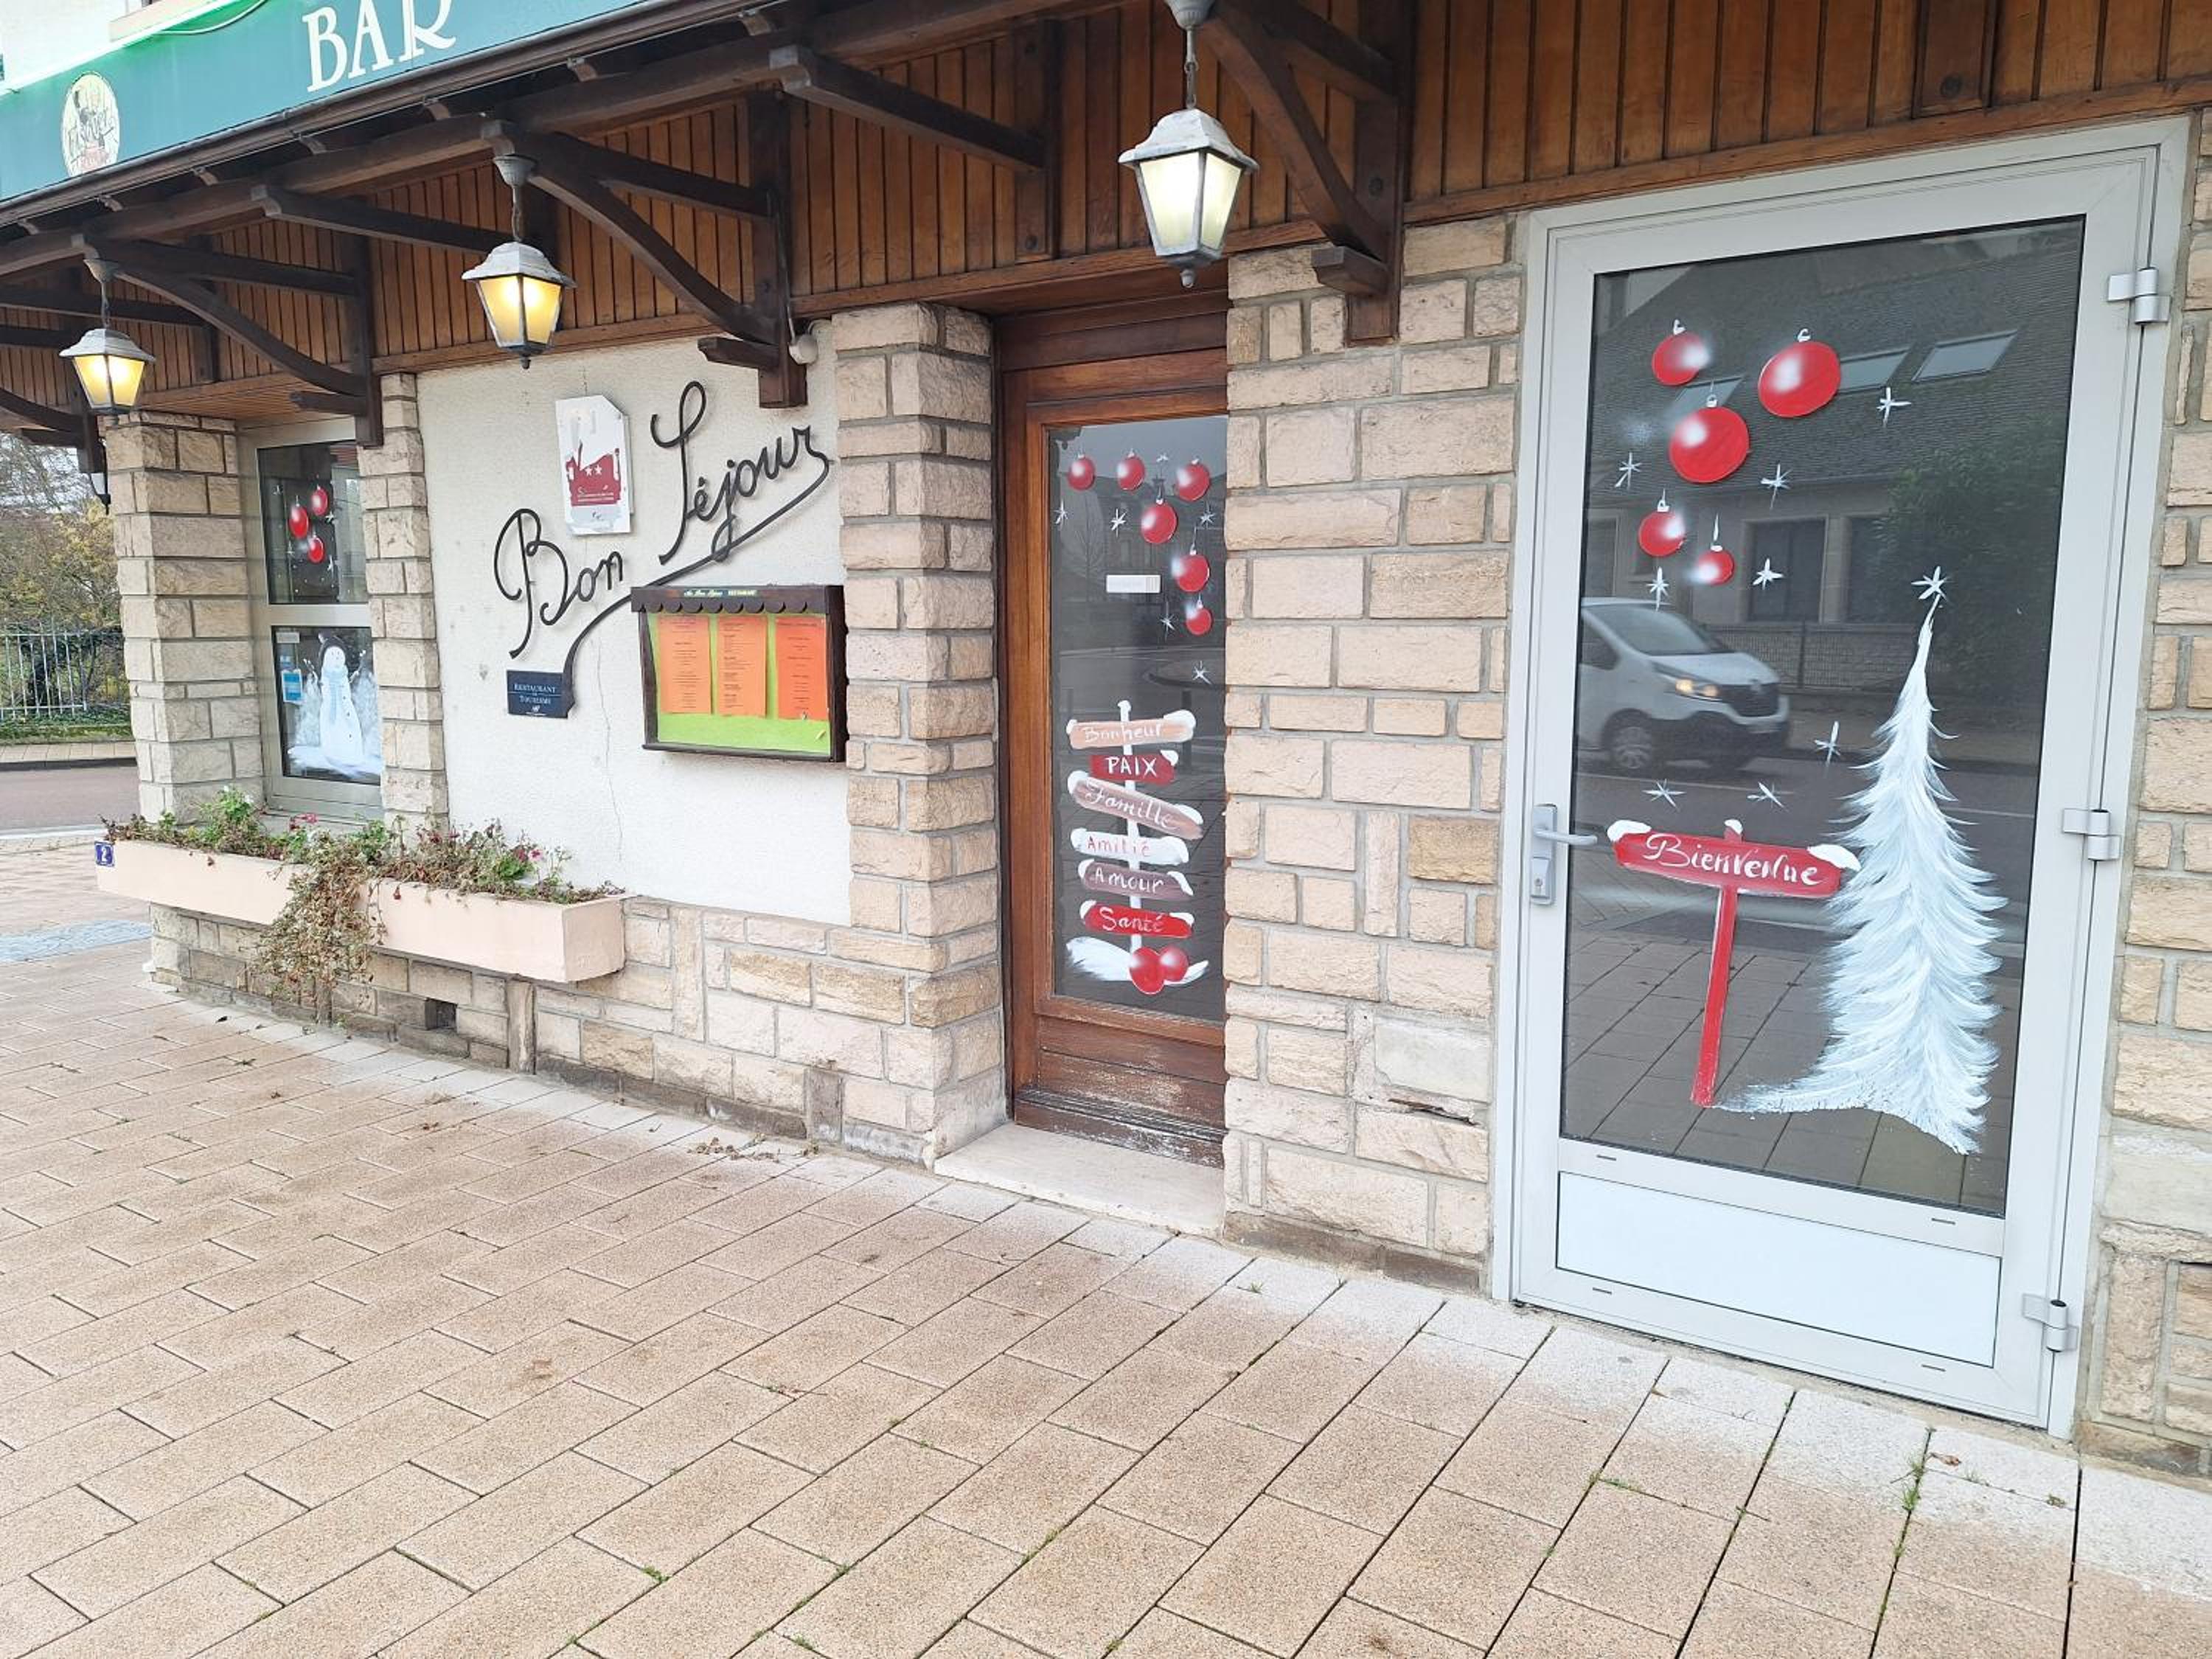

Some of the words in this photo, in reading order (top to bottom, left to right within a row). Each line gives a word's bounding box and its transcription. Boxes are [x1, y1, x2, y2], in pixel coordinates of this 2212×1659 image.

[302, 0, 456, 92] BAR
[494, 509, 623, 658] Bon
[650, 380, 829, 563] Séjour
[1082, 722, 1162, 742] Bonheur
[1105, 756, 1157, 777] PAIX
[1083, 779, 1180, 830] Famille
[101, 846, 108, 862] 2
[1087, 835, 1150, 858] Amitié
[1642, 832, 1824, 886] Bienvenue
[1094, 868, 1166, 893] Amour
[1099, 906, 1164, 933] Santé
